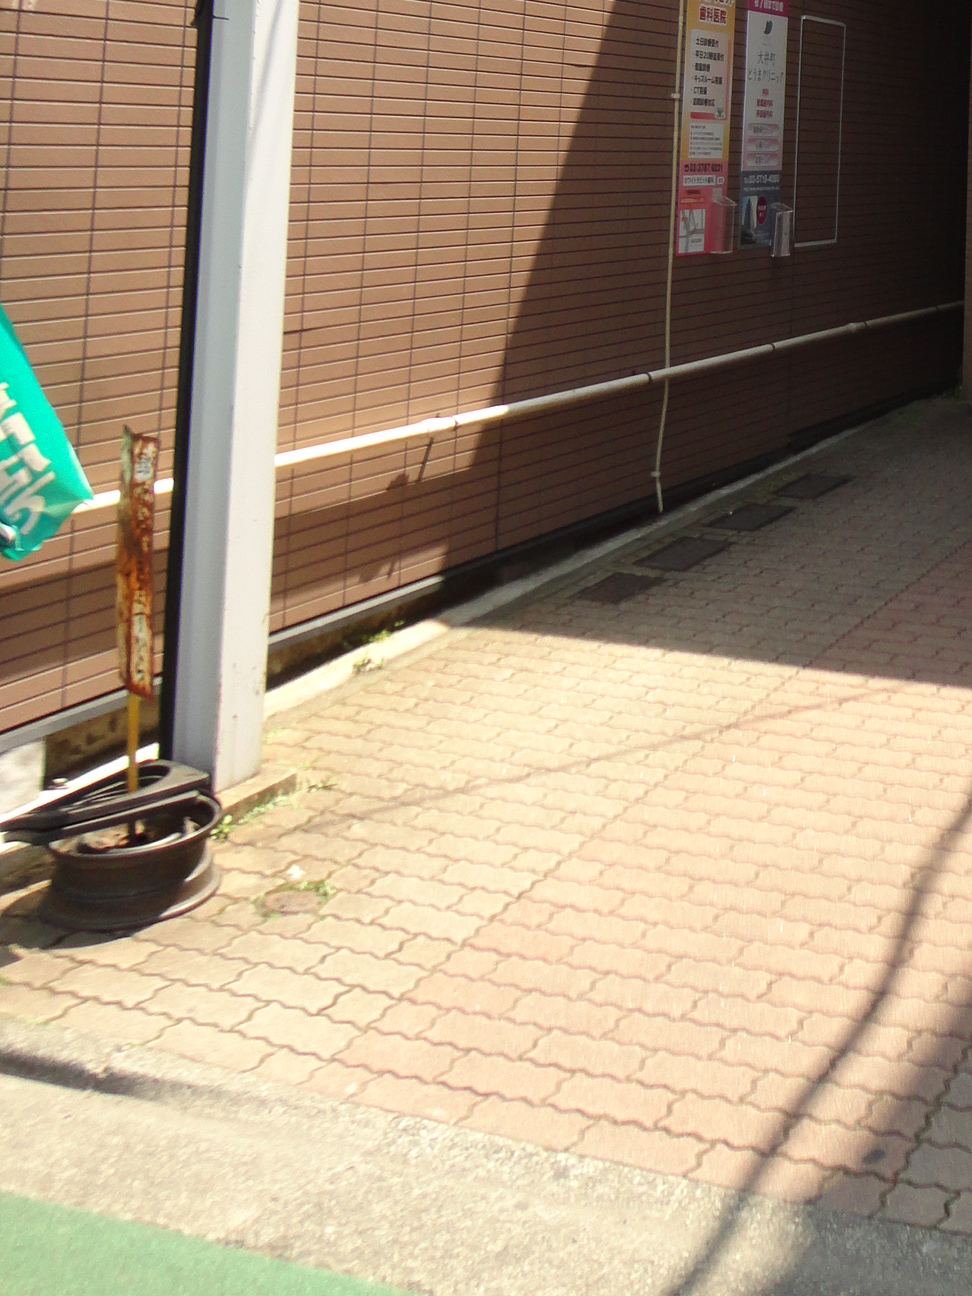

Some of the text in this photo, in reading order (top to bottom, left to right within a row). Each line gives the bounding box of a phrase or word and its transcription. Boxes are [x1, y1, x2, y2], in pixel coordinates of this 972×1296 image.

[698, 4, 728, 26] 歯科医院
[757, 51, 777, 67] 大井町
